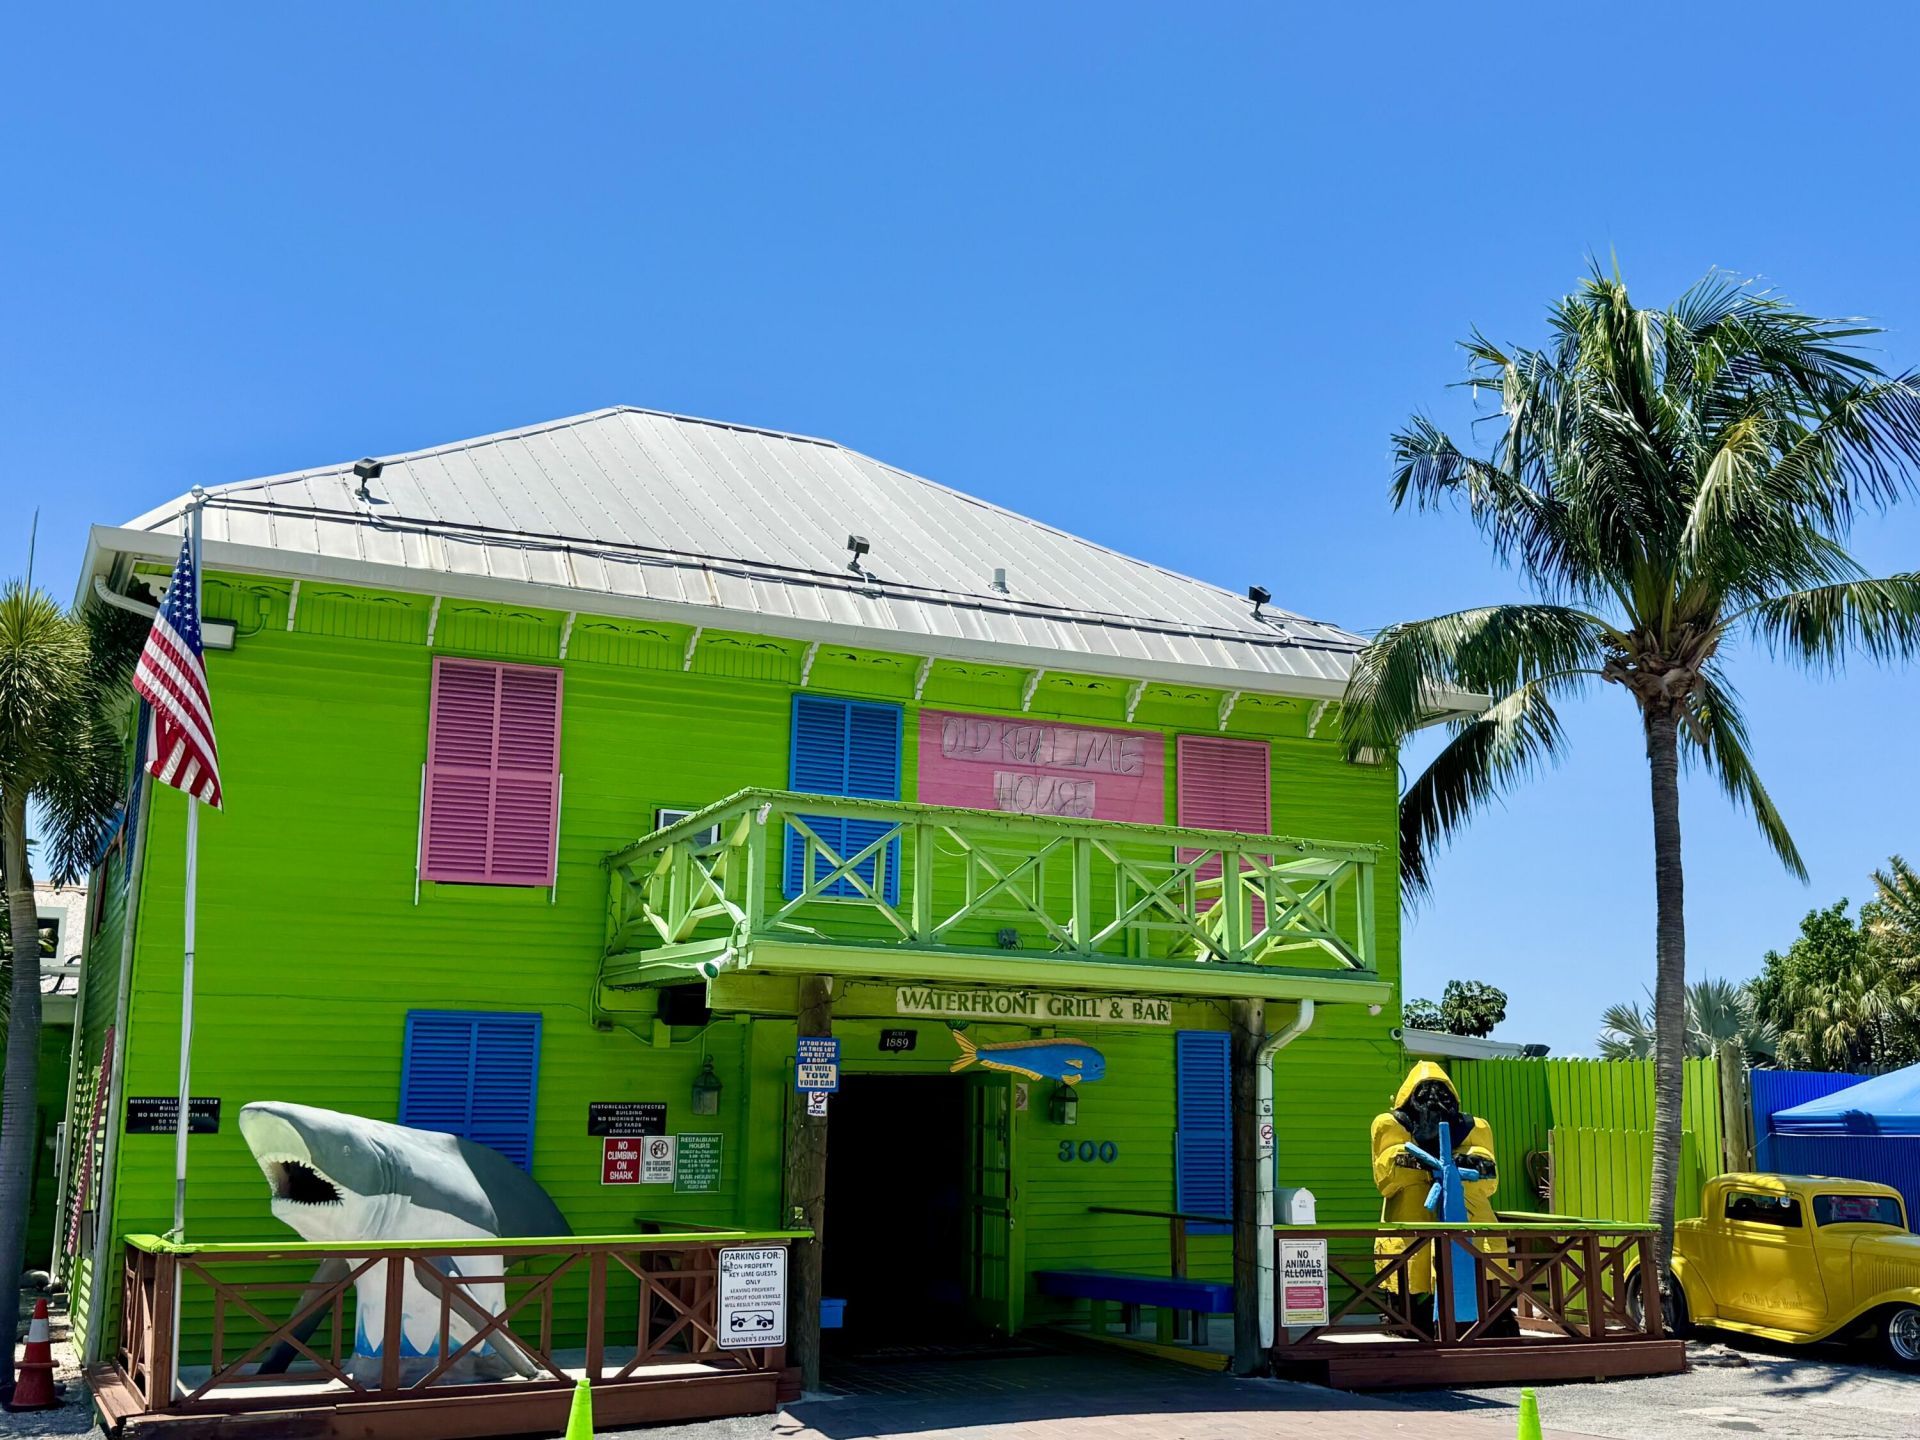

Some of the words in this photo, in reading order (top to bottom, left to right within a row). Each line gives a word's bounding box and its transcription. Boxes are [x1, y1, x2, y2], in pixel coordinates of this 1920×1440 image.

[943, 719, 992, 754] OLD
[1046, 728, 1144, 774] LIME
[997, 773, 1094, 816] HOUSE
[902, 990, 1040, 1015] WATERFRONT
[1047, 995, 1101, 1018] GRILL
[1109, 1001, 1123, 1019] &
[1132, 1001, 1168, 1021] BAR
[886, 1038, 909, 1048] 1889
[618, 1141, 628, 1150] NO
[607, 1151, 638, 1160] CLIMBING
[1058, 1140, 1118, 1163] 300
[617, 1161, 627, 1169] ON
[609, 1171, 633, 1180] SHARK
[724, 1252, 760, 1260] PARKING
[1297, 1250, 1309, 1259] NO
[1285, 1260, 1321, 1268] ANIMALS
[1285, 1269, 1323, 1278] ALLOWED
